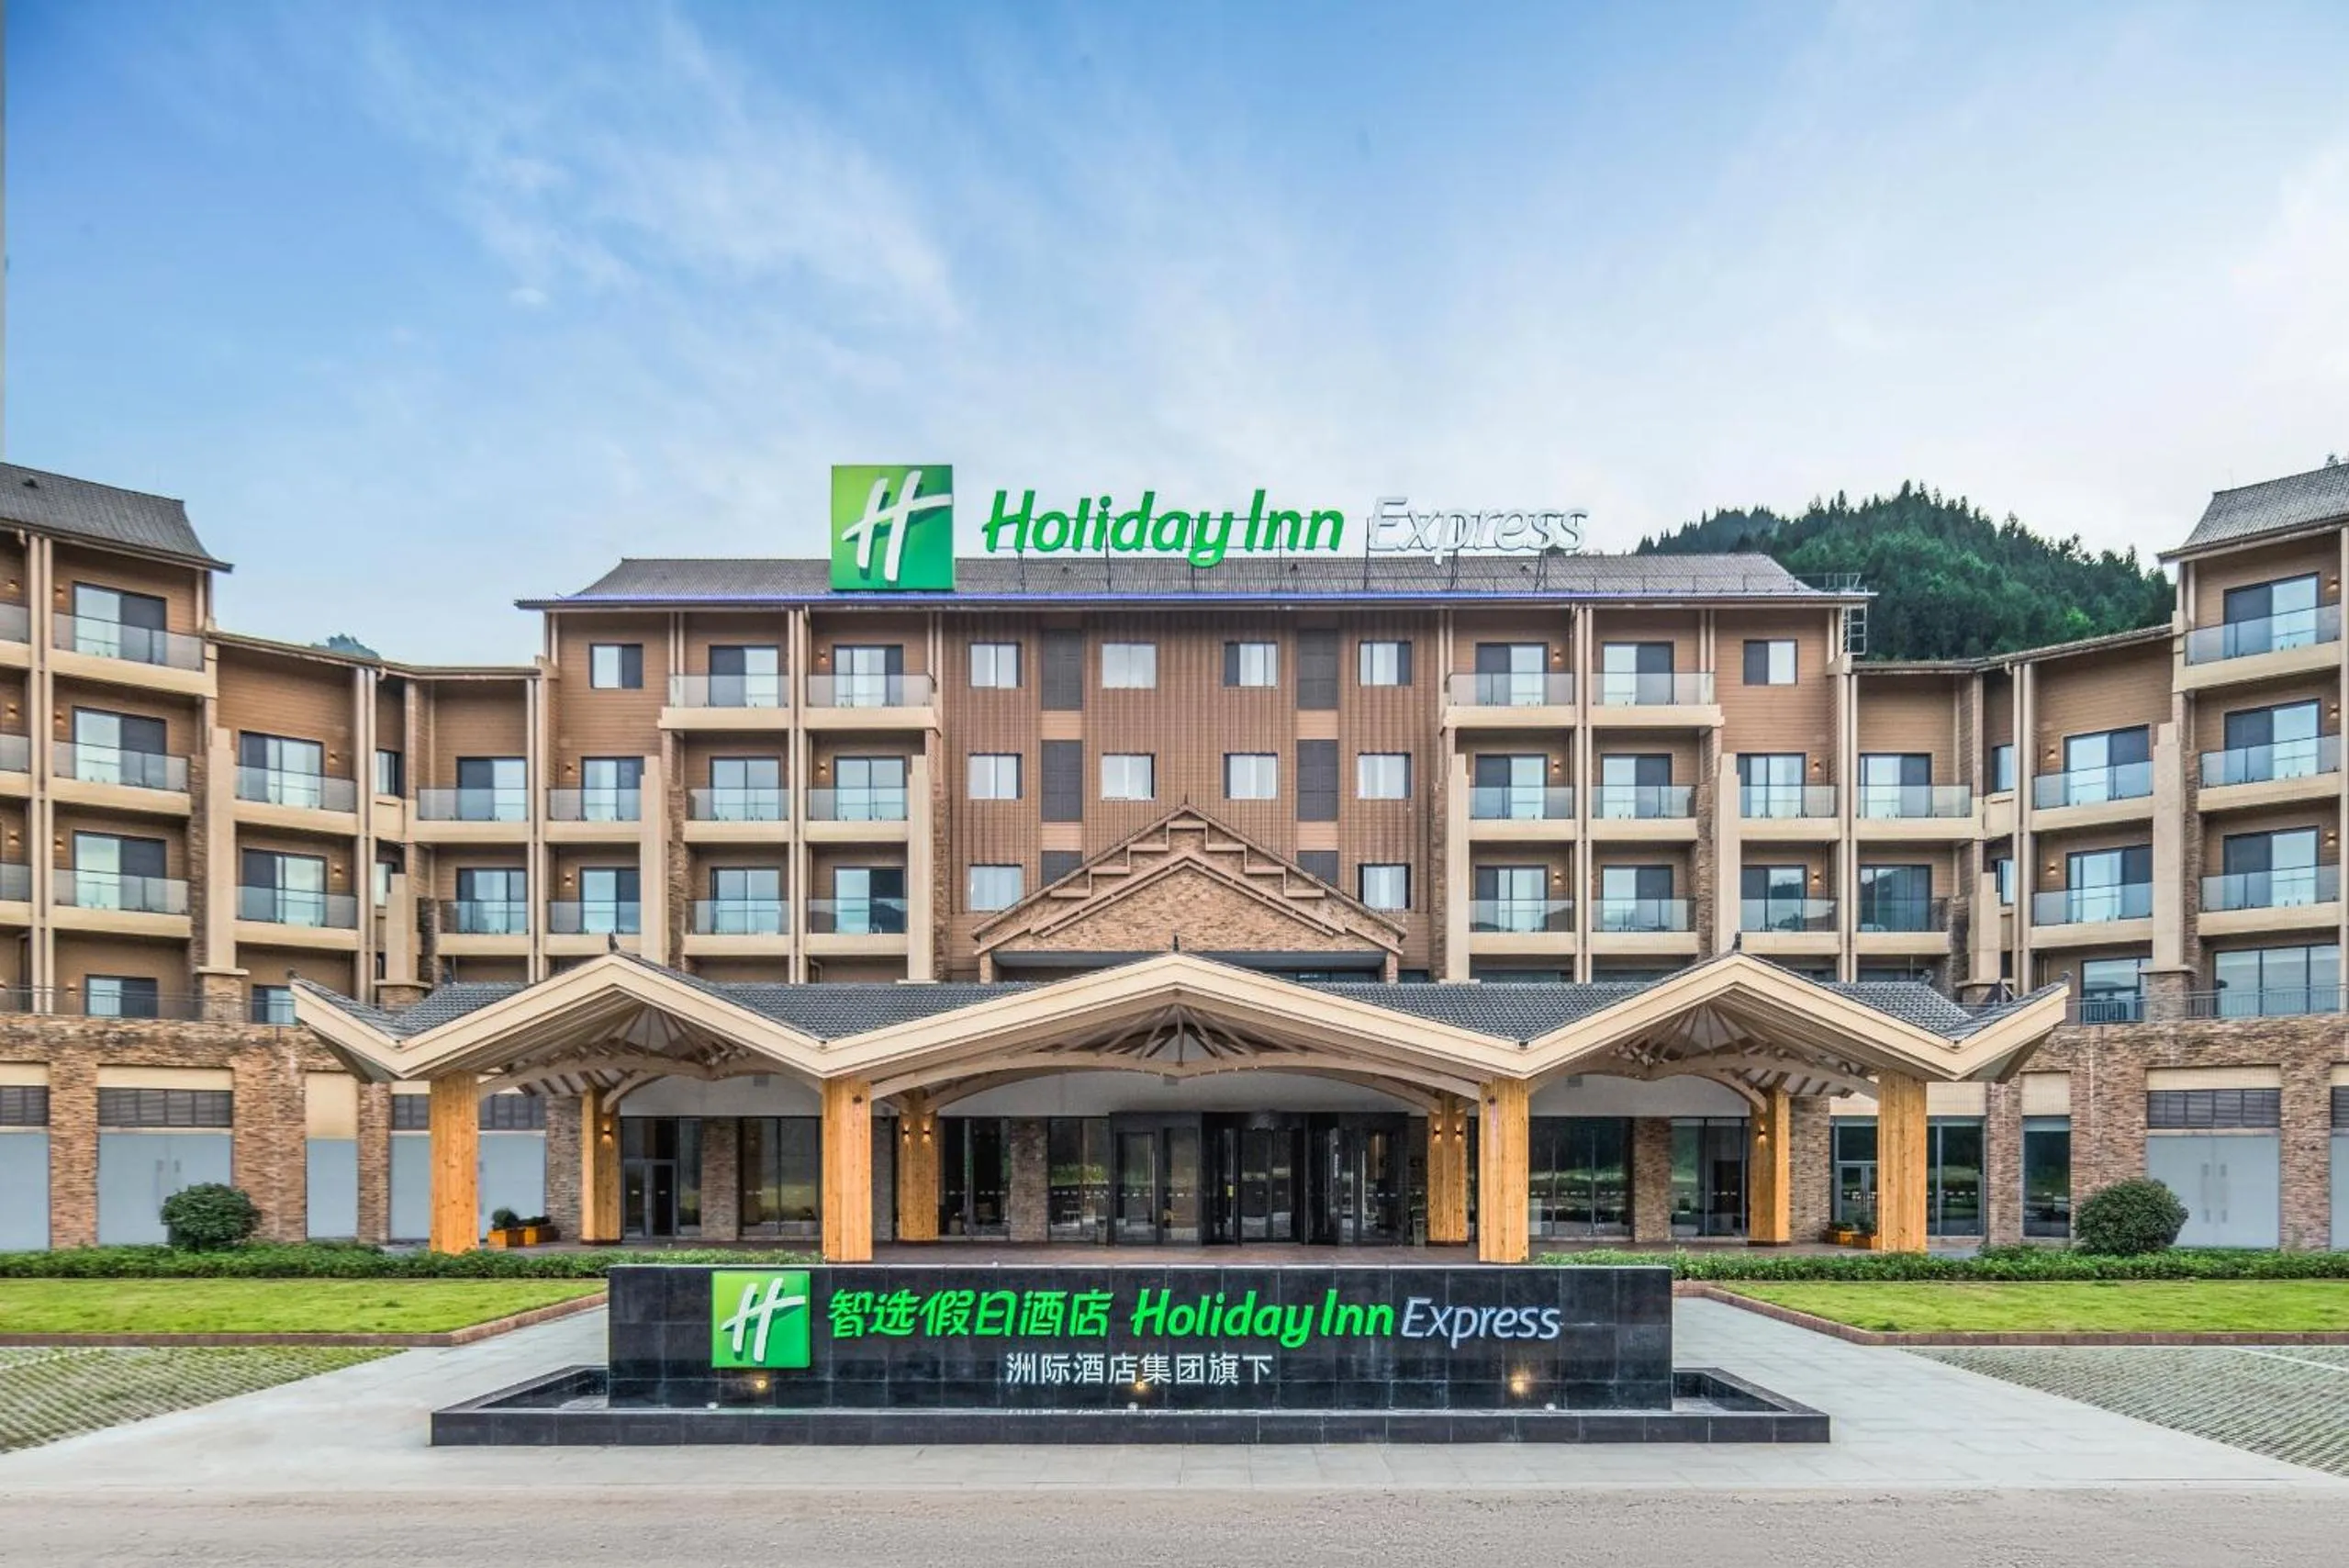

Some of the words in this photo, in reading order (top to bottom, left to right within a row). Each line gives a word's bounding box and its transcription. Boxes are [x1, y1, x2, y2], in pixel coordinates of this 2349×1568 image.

[1367, 496, 1586, 566] Express
[827, 1288, 1115, 1338] 智选假日酒店
[1401, 1296, 1561, 1350] Express
[1005, 1351, 1274, 1386] 洲际酒店集团旗下
